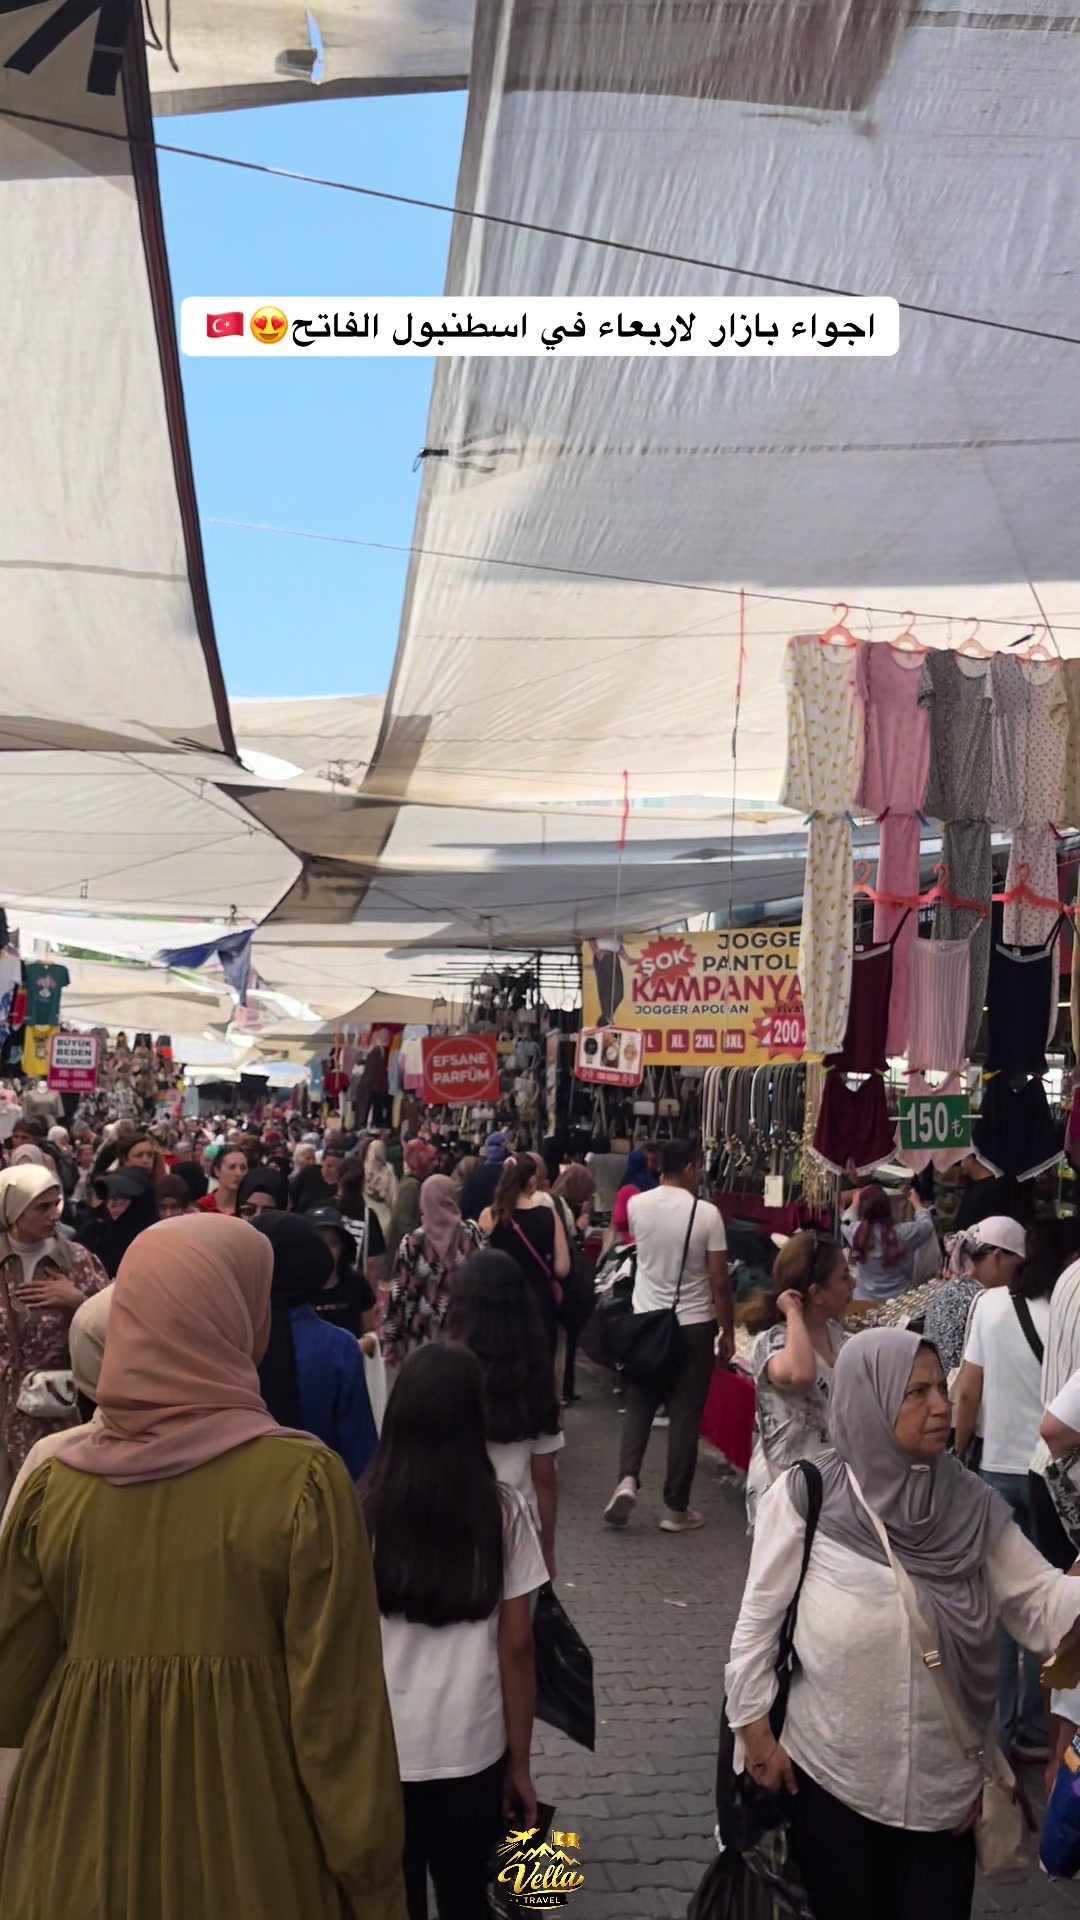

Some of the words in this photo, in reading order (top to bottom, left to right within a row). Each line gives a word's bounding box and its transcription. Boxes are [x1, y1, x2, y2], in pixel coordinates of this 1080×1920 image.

[641, 946, 690, 977] ŞOK
[634, 1005, 688, 1015] JOGGER
[773, 1019, 800, 1044] 200
[57, 1038, 92, 1047] BÜYÜK
[671, 1033, 685, 1048] XL
[695, 1033, 716, 1049] 2XL
[56, 1048, 92, 1057] BEDEN
[432, 1052, 488, 1067] EFSANE
[432, 1066, 491, 1084] PARFÜM
